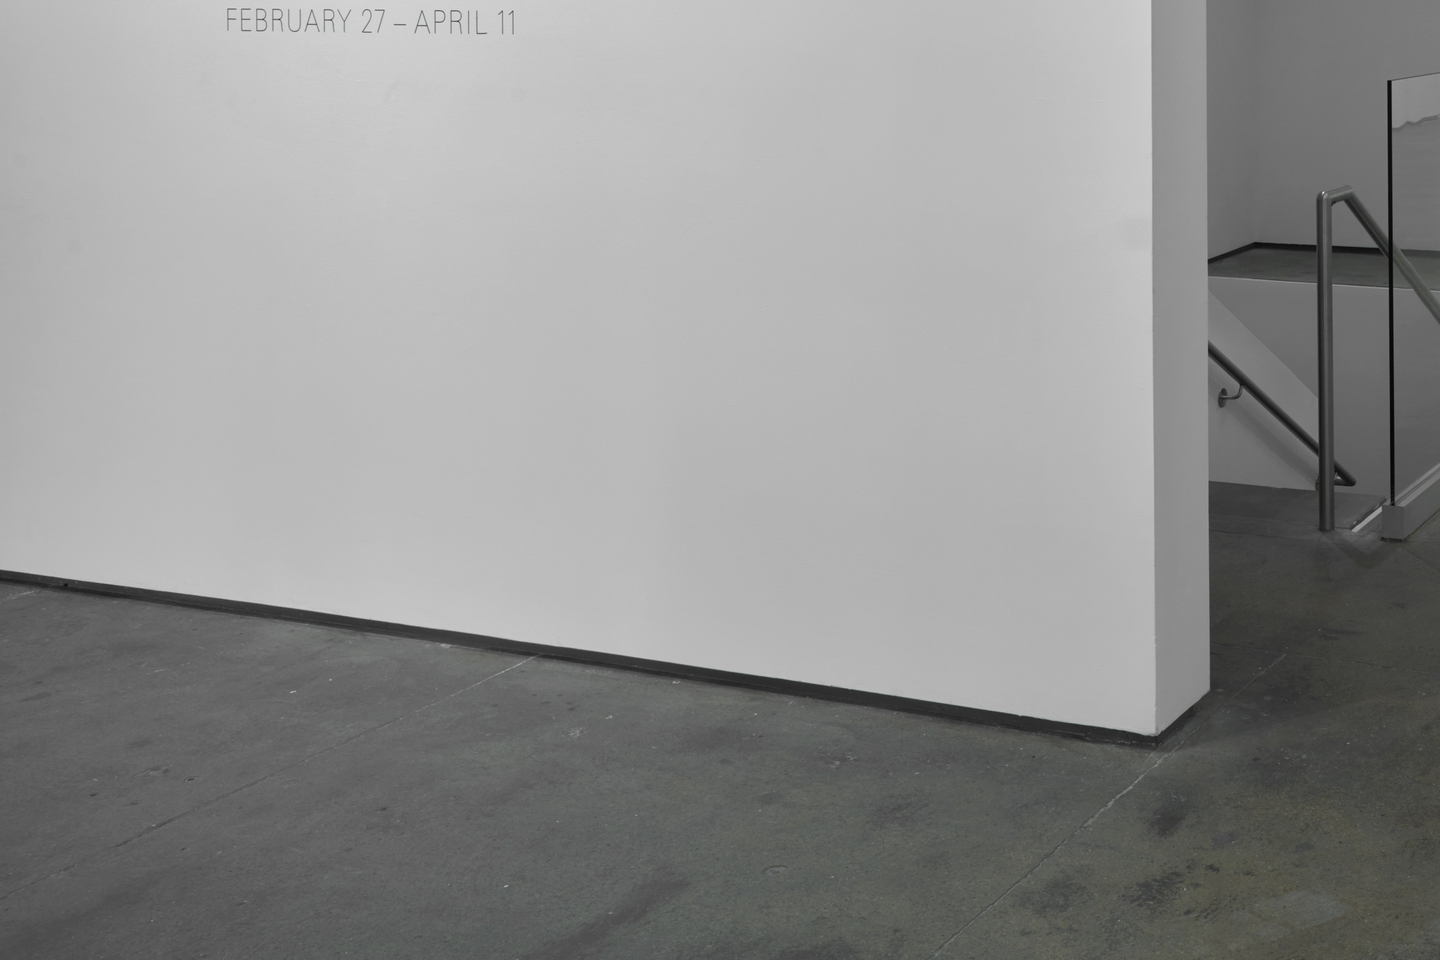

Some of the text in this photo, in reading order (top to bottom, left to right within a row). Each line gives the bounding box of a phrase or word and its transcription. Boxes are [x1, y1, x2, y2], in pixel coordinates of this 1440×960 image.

[226, 7, 352, 33] FEBRUARY
[361, 8, 386, 34] 27
[413, 9, 488, 35] APRIL
[497, 9, 515, 35] 11
